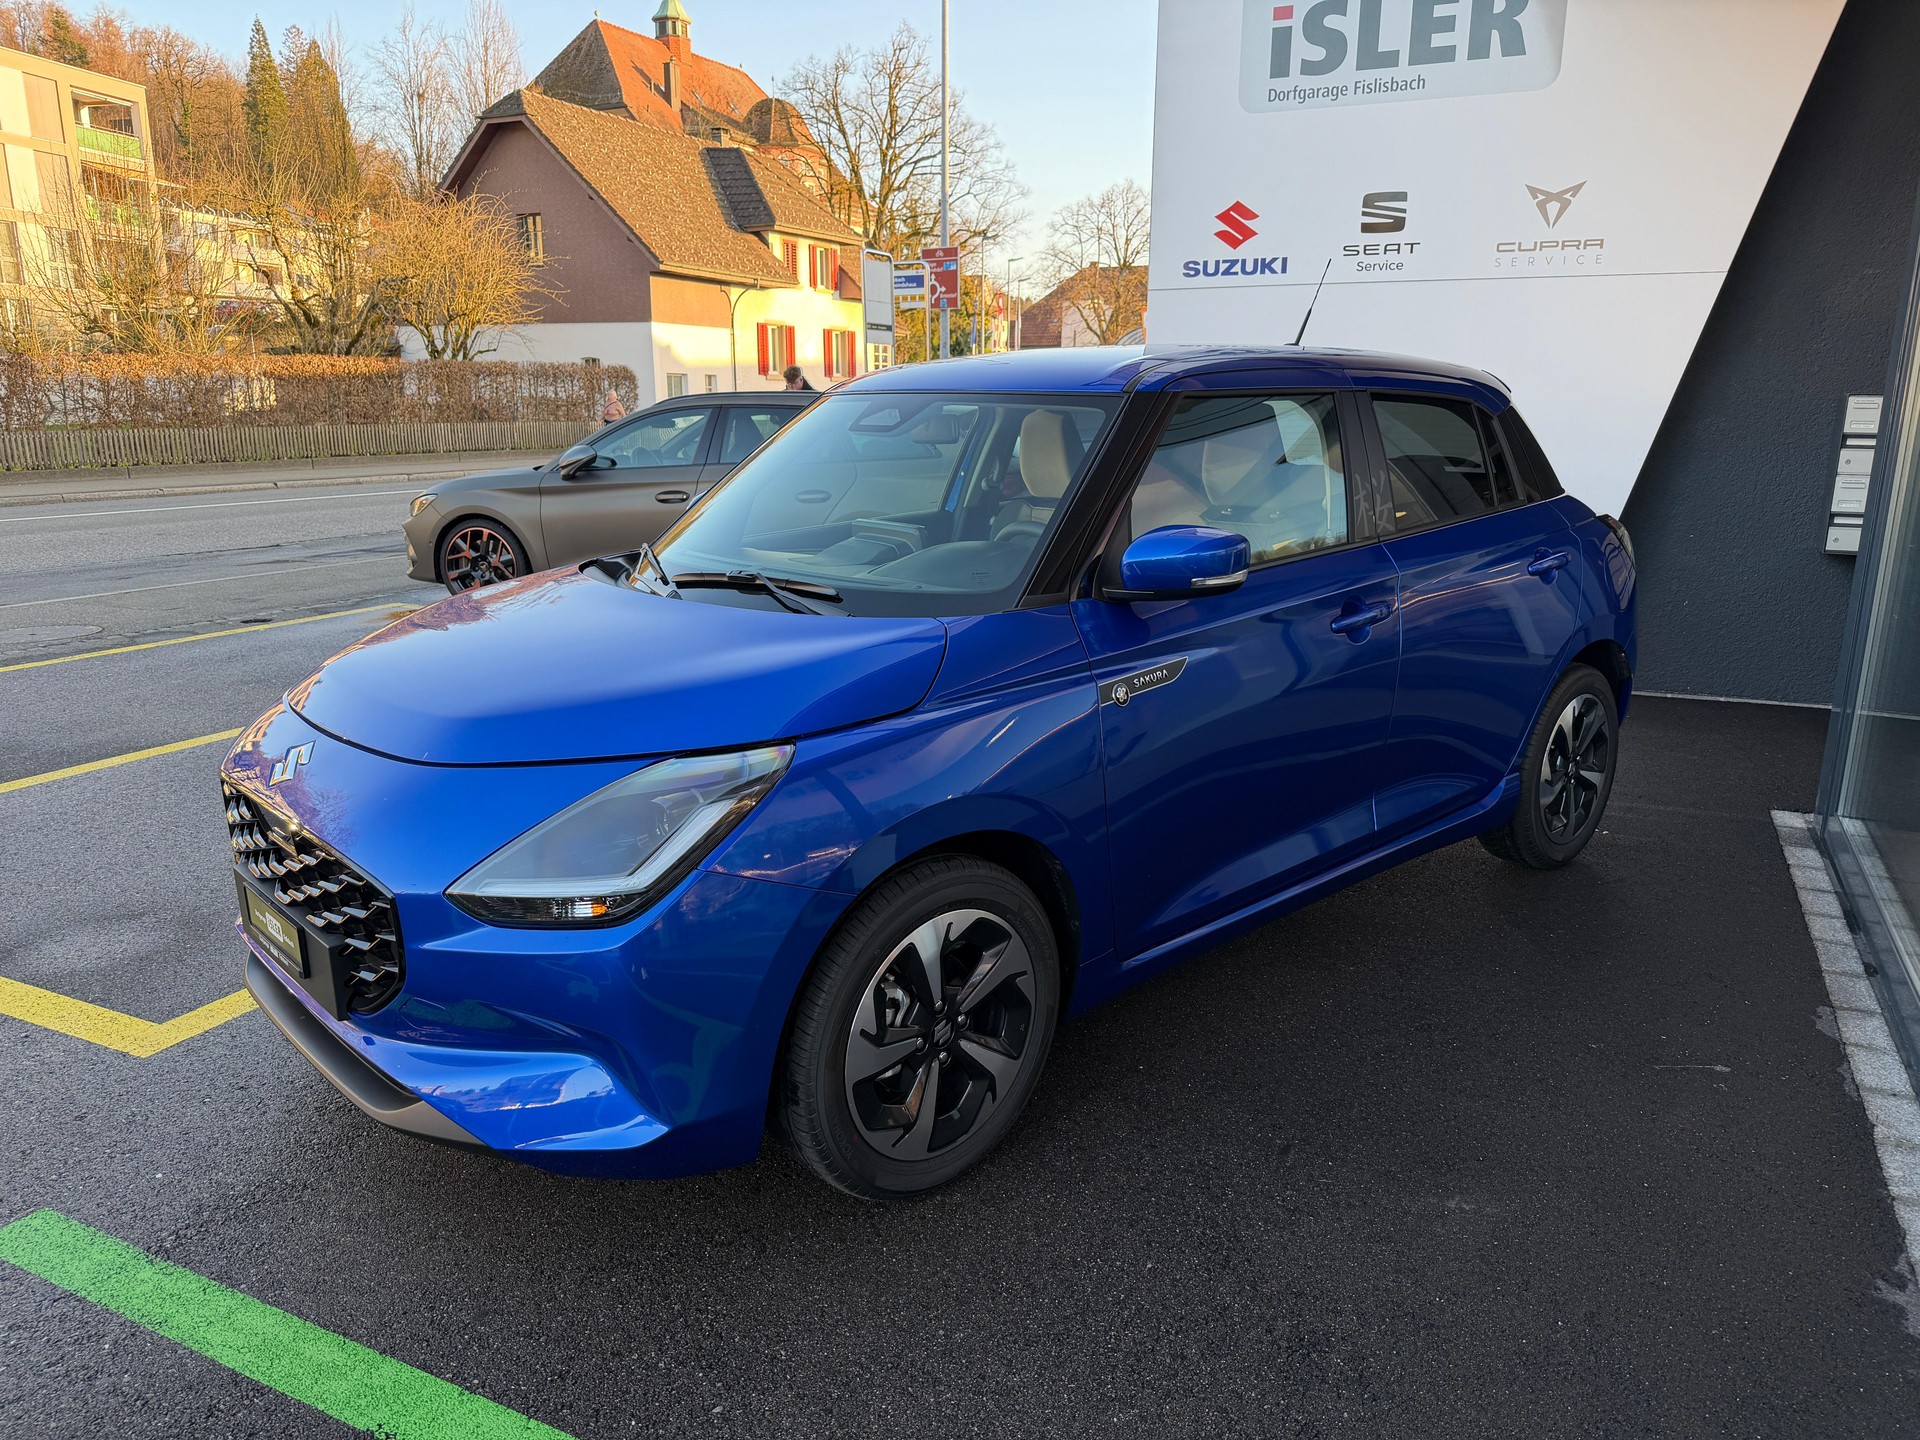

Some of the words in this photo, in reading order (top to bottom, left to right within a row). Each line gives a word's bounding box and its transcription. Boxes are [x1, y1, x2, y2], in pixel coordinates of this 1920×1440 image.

[1267, 84, 1349, 104] Dorfgarage
[1353, 74, 1426, 95] Fislisbach
[1342, 242, 1421, 257] SEAT
[1496, 238, 1605, 253] CUPRA
[1182, 256, 1288, 278] SUZUKI
[1356, 259, 1404, 273] Service
[1494, 253, 1603, 268] SERVICE
[1133, 669, 1168, 688] SAKURA
